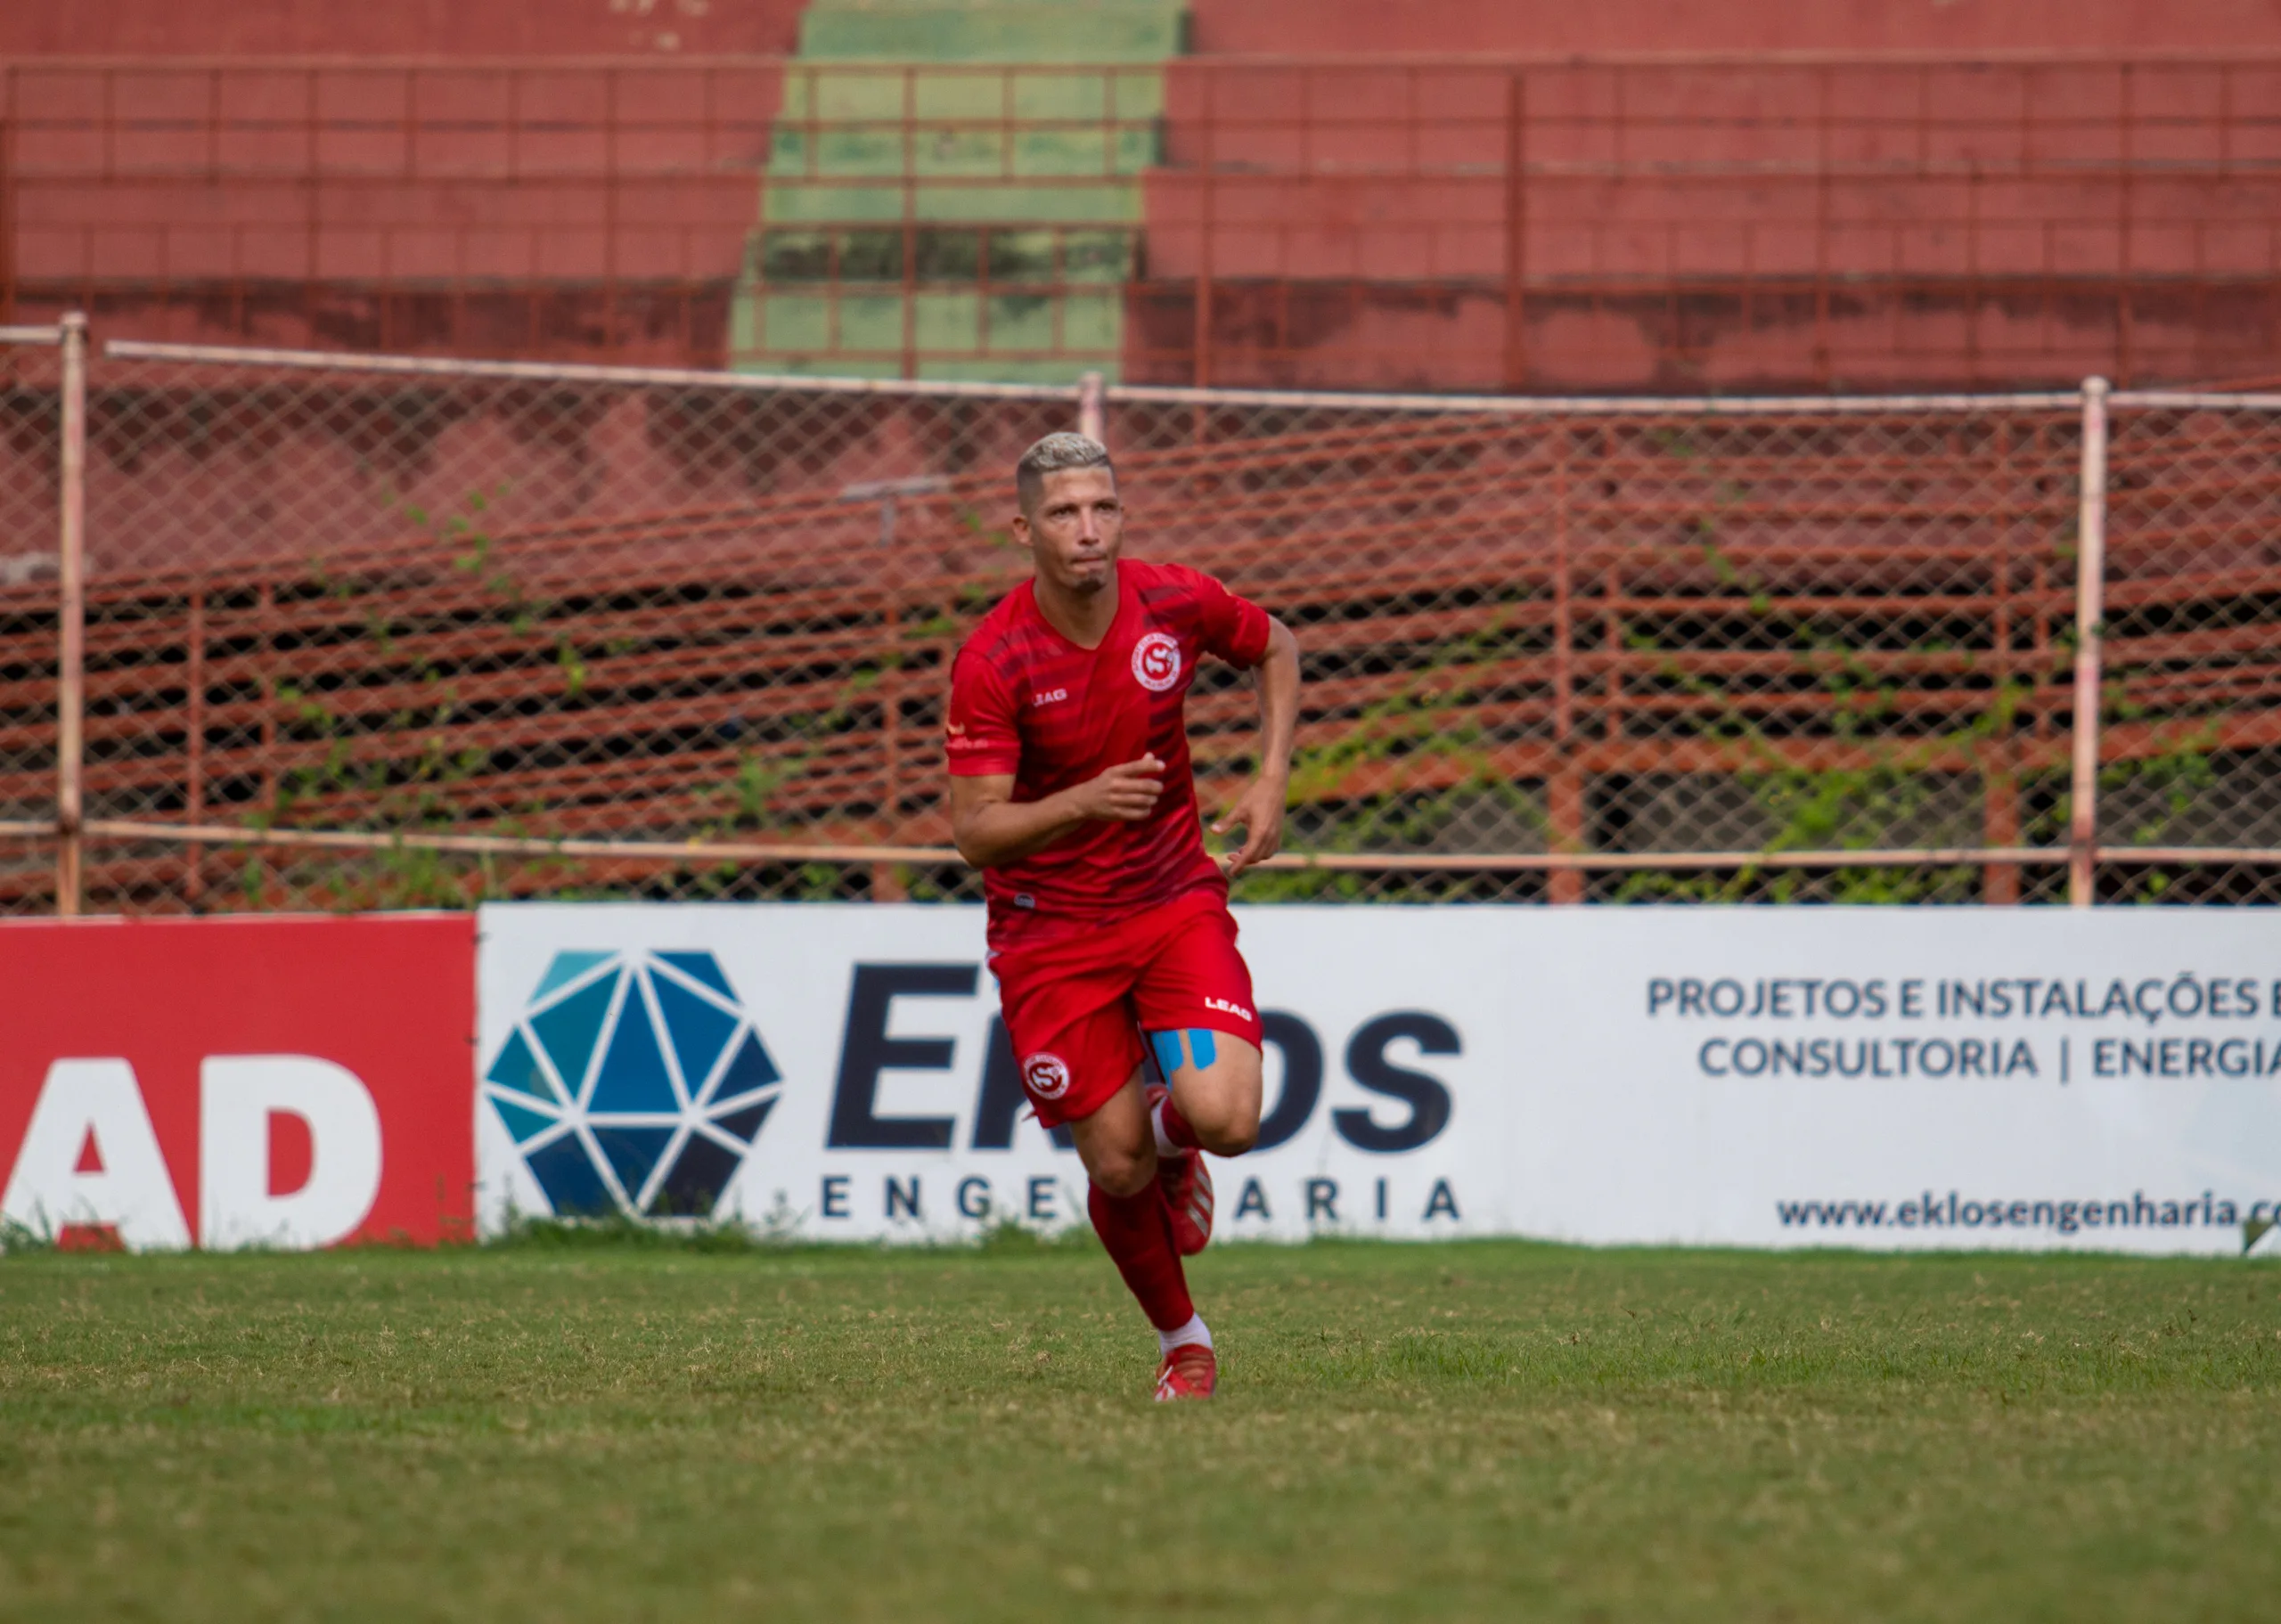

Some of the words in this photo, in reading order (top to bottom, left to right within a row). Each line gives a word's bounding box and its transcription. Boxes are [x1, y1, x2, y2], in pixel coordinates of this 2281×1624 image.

[1647, 978, 1888, 1018] PROJETOS
[1899, 978, 1924, 1018] E
[1938, 972, 2261, 1025] INSTALAÇÕES
[1698, 1038, 2040, 1078] CONSULTORIA
[822, 1175, 1461, 1219] ENGEARIA
[1778, 1191, 2281, 1235] www.eklosengenhariac
